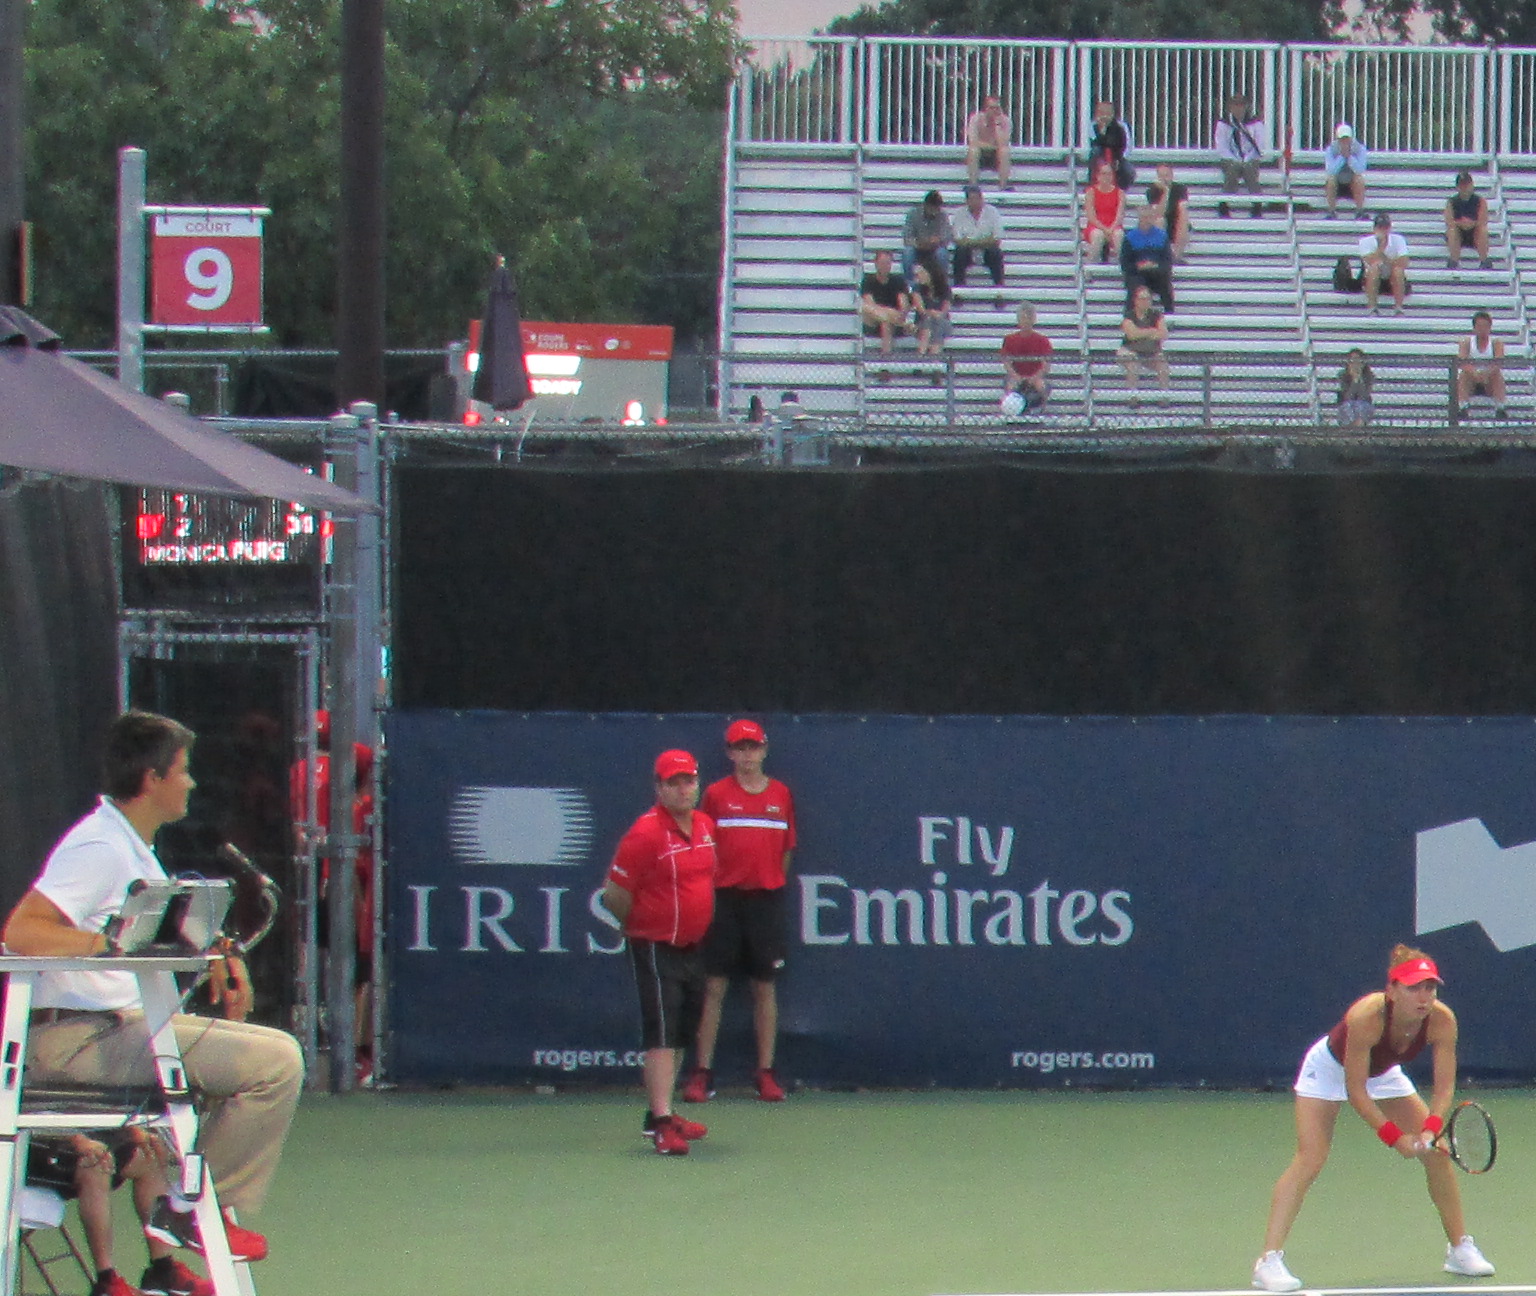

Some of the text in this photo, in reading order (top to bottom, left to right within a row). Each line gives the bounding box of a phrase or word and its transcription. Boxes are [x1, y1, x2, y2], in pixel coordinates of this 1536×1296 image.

[186, 222, 232, 233] COURT
[184, 247, 234, 311] 9
[918, 815, 1015, 876] Fly
[407, 884, 627, 954] IRIS
[796, 871, 1135, 946] Emirates
[1011, 1051, 1156, 1073] rogers.com
